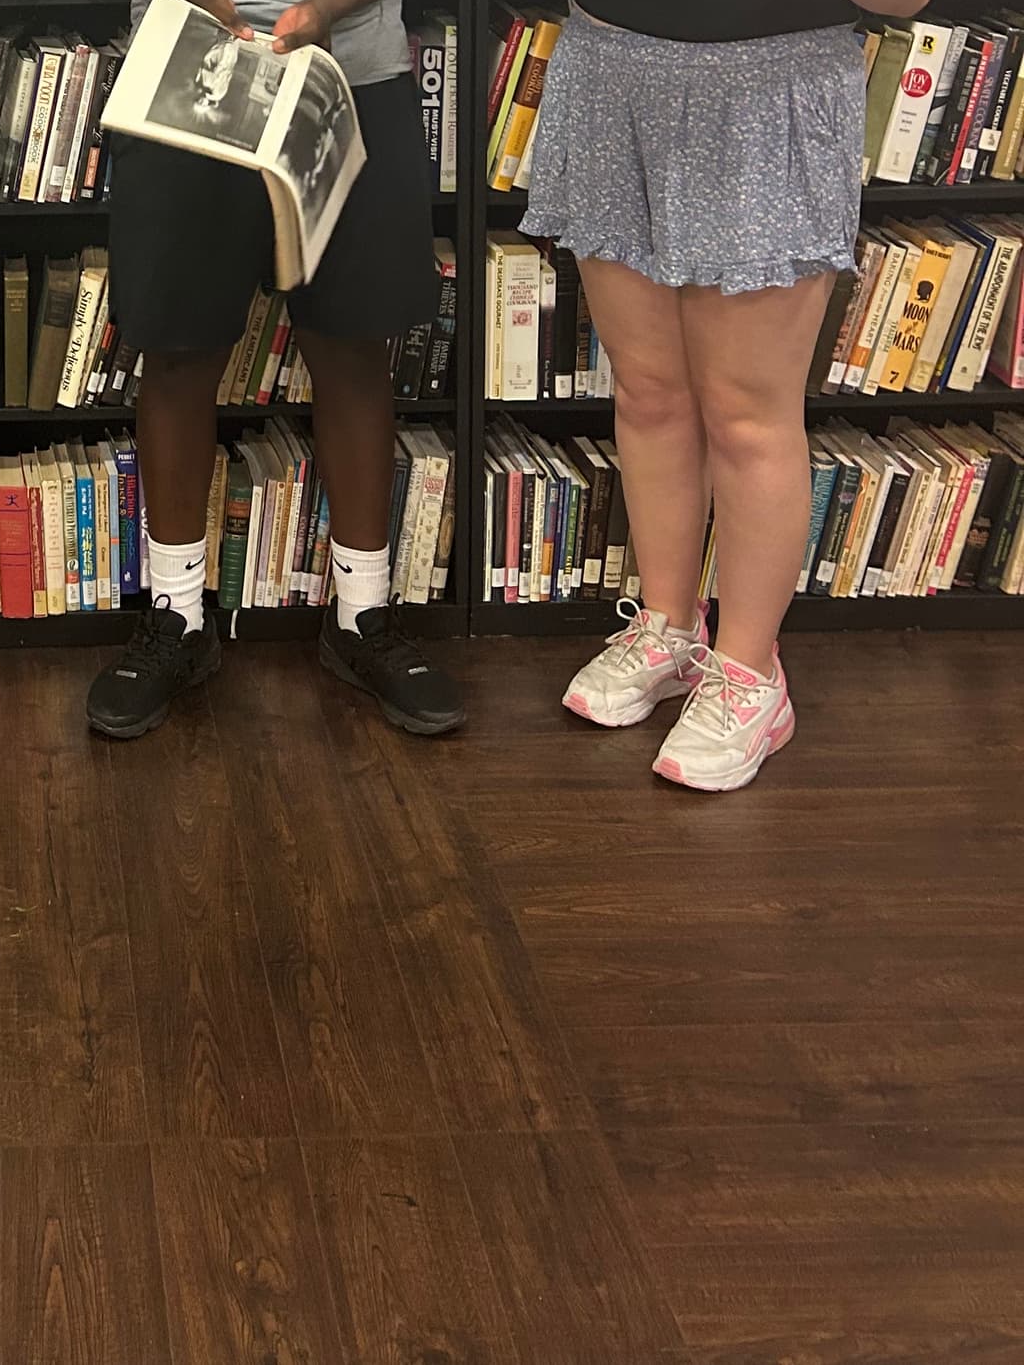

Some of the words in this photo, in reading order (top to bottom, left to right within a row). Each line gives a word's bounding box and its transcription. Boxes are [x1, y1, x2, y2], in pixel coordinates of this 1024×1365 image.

[922, 36, 933, 49] R
[421, 48, 443, 109] 501
[903, 69, 926, 91] joy
[1000, 70, 1013, 104] VEGETABLE
[430, 109, 440, 163] MUST-VISIT
[884, 252, 901, 286] BAKING
[1004, 246, 1014, 260] THE
[987, 261, 1009, 309] ABANDONMENT
[74, 289, 92, 333] Simply
[903, 301, 932, 323] MOON
[982, 311, 992, 320] OF
[866, 314, 879, 344] HEART
[973, 335, 984, 350] JEWS
[978, 321, 989, 335] THE
[62, 337, 84, 392] Delicious
[239, 334, 258, 384] AMERICANS
[889, 371, 899, 383] 7
[126, 474, 137, 519] Hilarious
